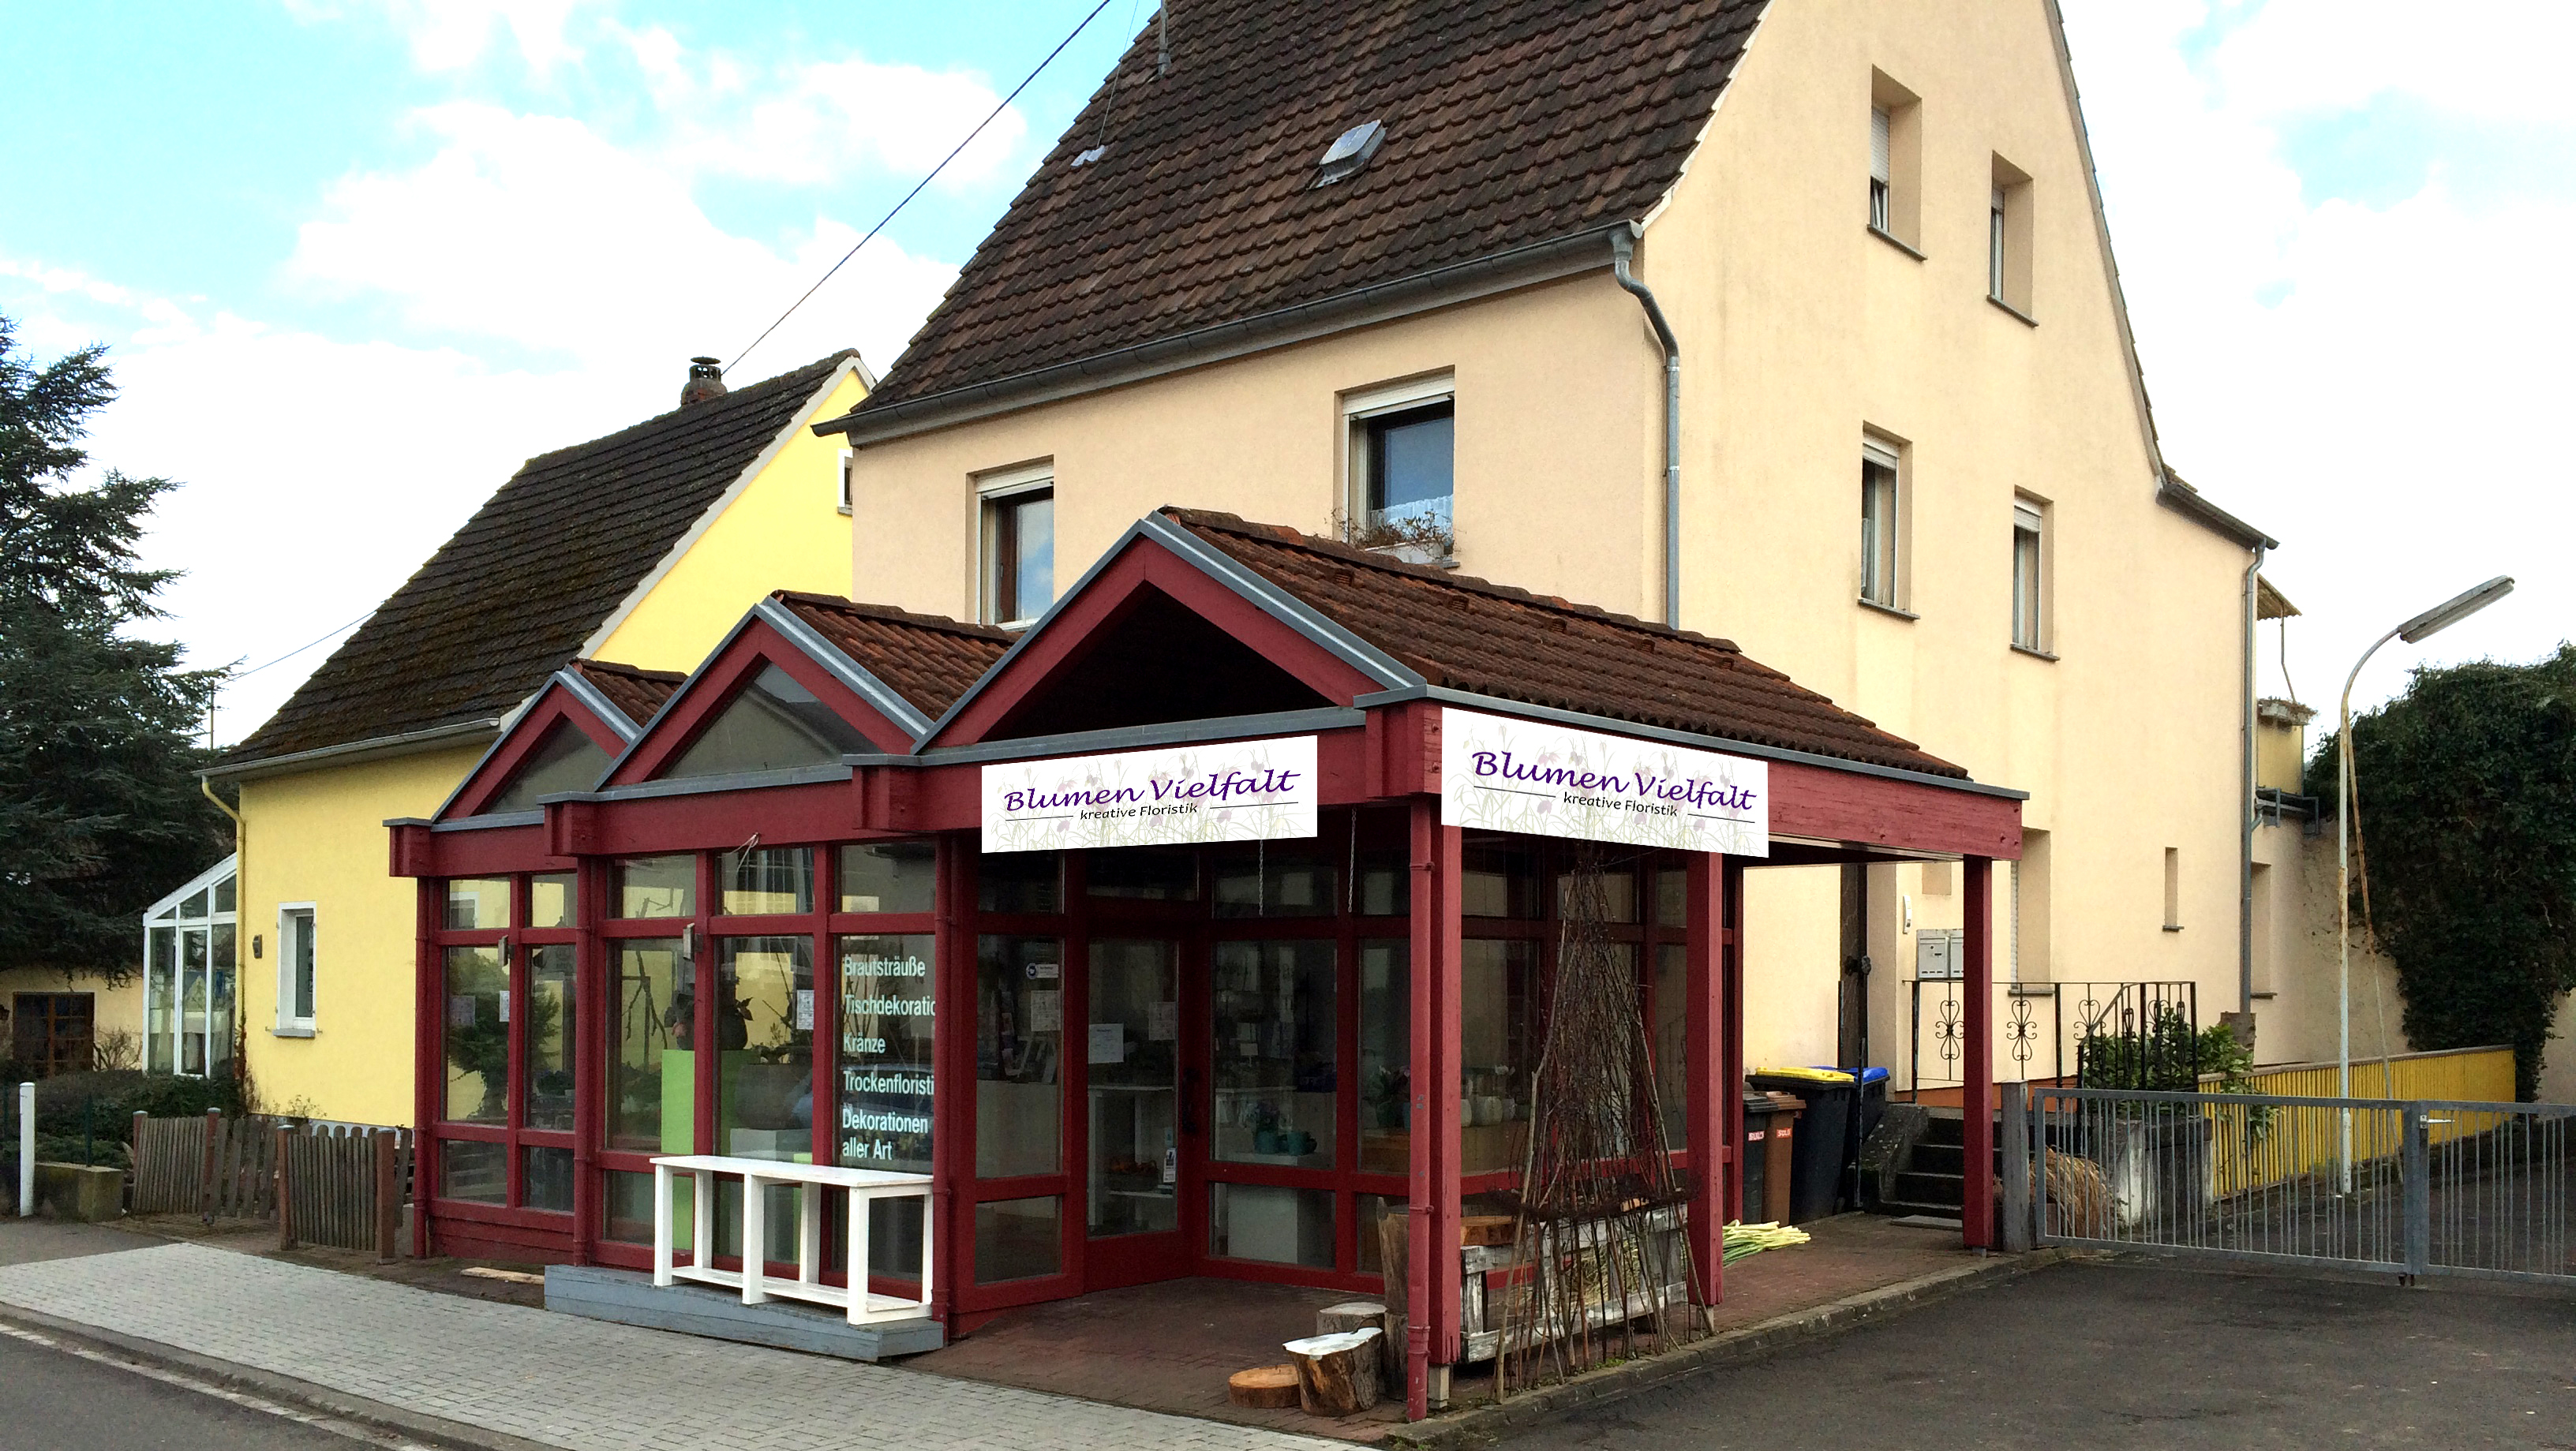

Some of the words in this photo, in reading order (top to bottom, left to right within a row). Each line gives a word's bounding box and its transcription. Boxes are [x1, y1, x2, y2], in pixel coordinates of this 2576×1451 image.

[1004, 787, 1145, 812] Blumen
[1149, 769, 1301, 802] Vielfalt
[1472, 750, 1631, 793] Blumen
[1634, 772, 1757, 810] Vielfalt
[1079, 809, 1136, 821] kreative
[1139, 802, 1198, 817] Floristik
[1563, 791, 1623, 811] kreative
[1624, 799, 1679, 817] Floristik
[844, 955, 926, 977] Brautsträuße
[843, 1031, 886, 1054] Kränze
[842, 1108, 928, 1134] Dekorationen
[842, 1136, 870, 1158] aller
[873, 1139, 893, 1161] Art
